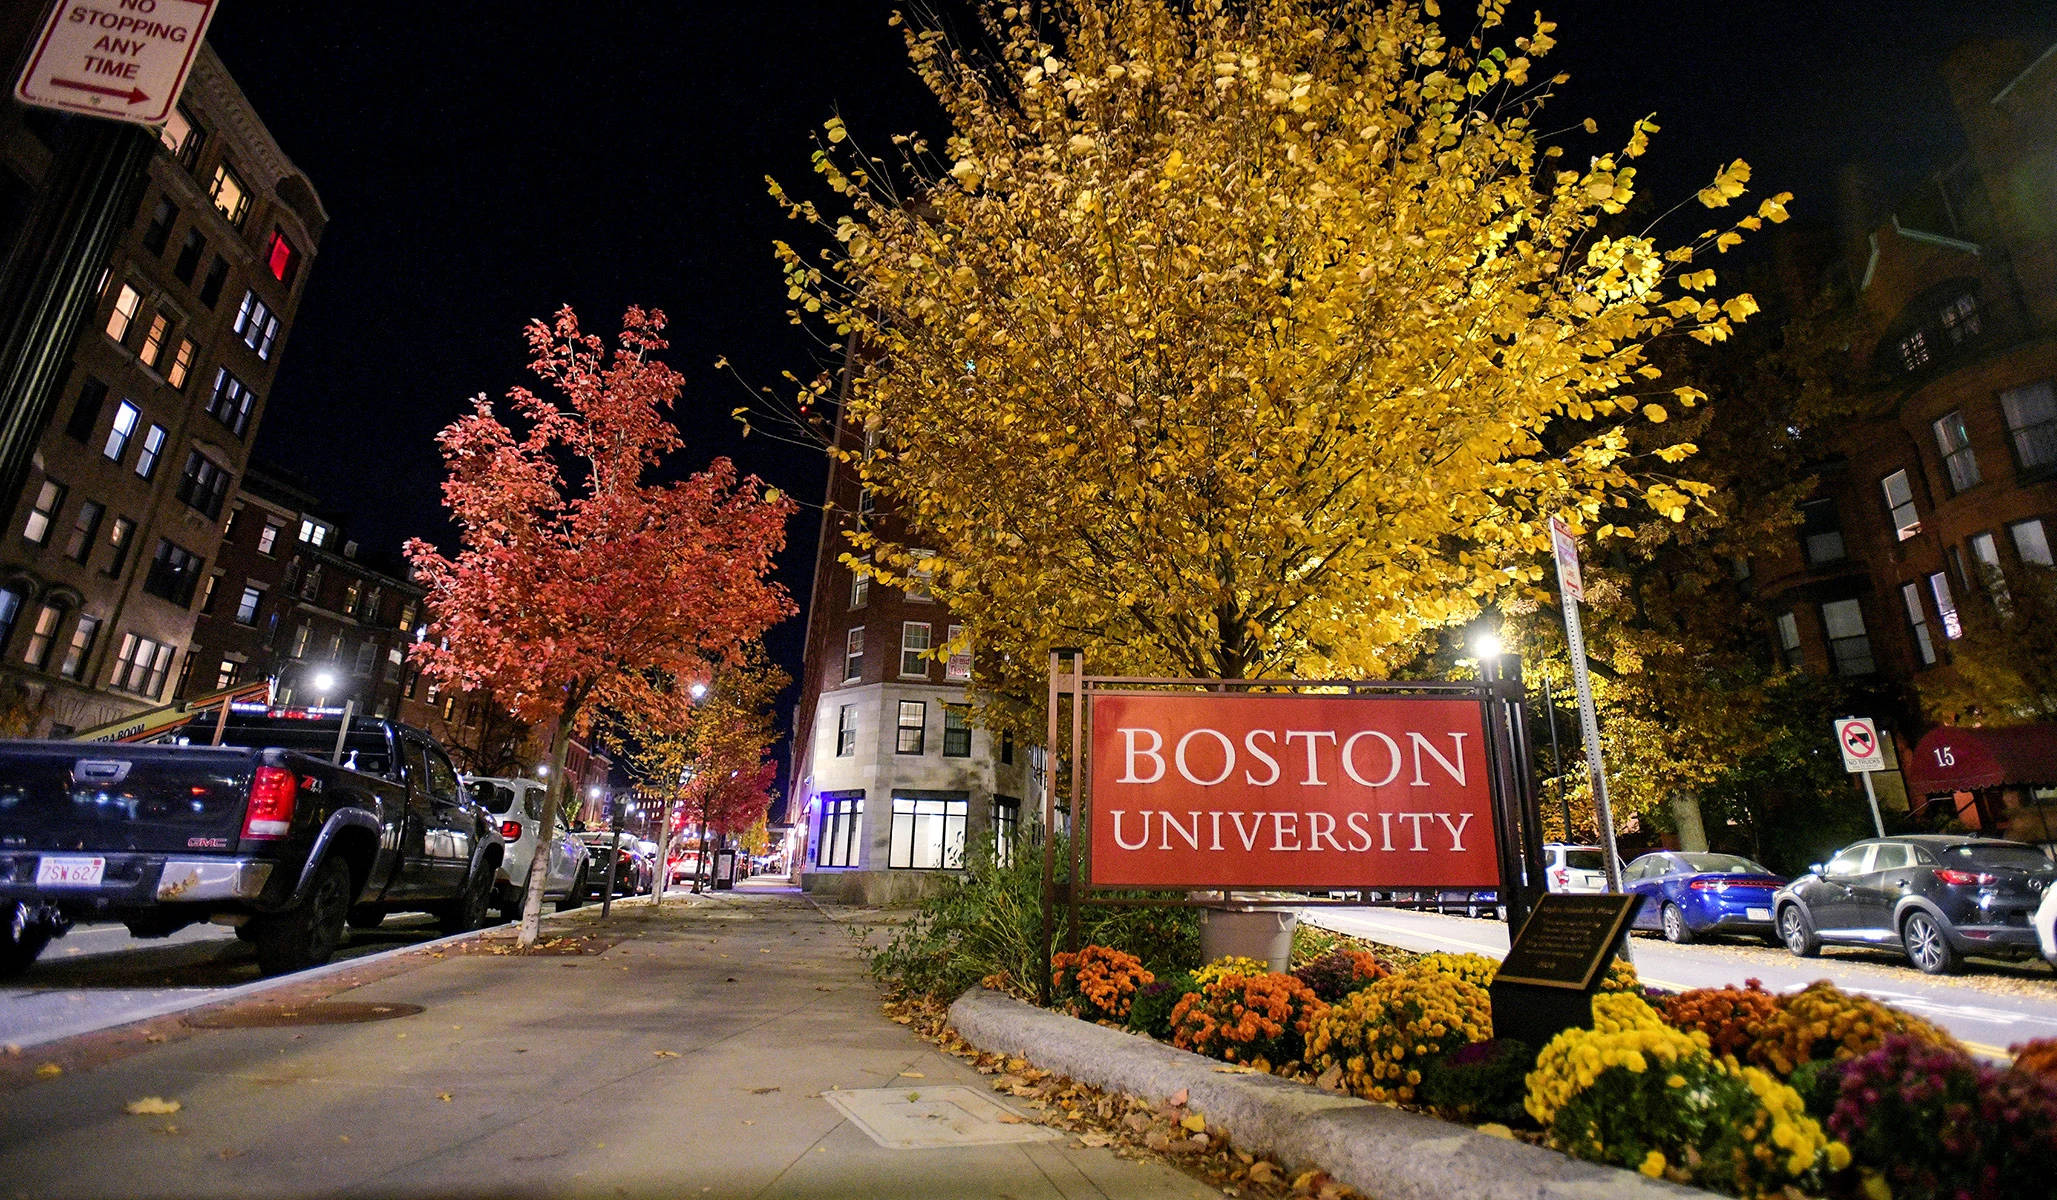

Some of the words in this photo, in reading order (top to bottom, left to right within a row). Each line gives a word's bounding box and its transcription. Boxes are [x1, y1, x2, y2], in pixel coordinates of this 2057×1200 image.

[120, 0, 156, 13] NO
[69, 7, 188, 43] STOPPING
[93, 35, 146, 57] ANY
[83, 55, 141, 80] TIME
[117, 723, 145, 740] BOOM
[1116, 728, 1468, 788] BOSTON
[1934, 746, 1955, 767] 15
[1110, 810, 1473, 852] UNIVERSITY
[187, 837, 228, 848] GMC
[72, 866, 99, 881] 627
